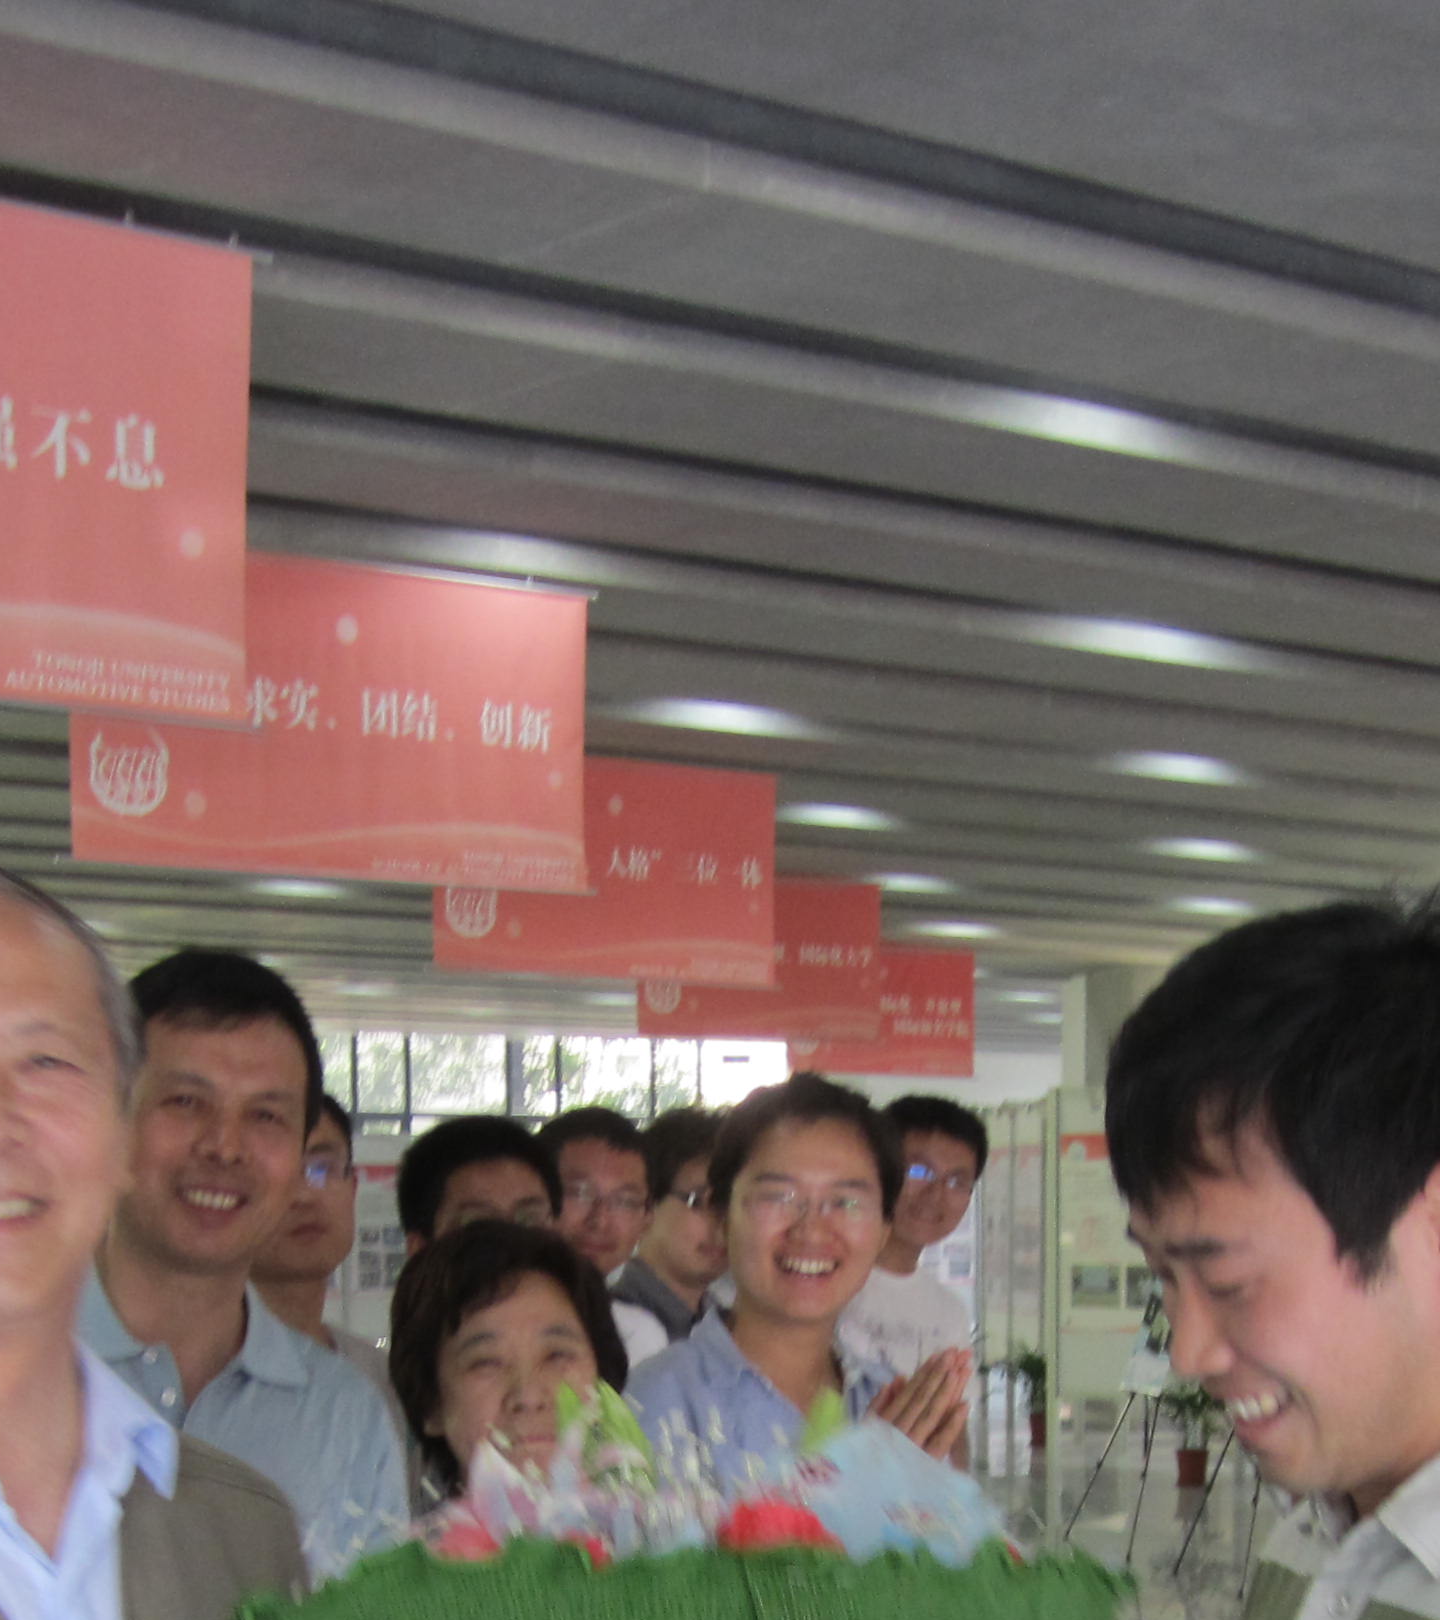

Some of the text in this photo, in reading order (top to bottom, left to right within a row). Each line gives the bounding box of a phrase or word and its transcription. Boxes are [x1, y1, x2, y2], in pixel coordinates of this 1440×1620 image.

[3, 670, 142, 703] AUTOMOTIVE
[149, 687, 232, 713] STUDIES
[112, 657, 232, 692] UNIVERSITY
